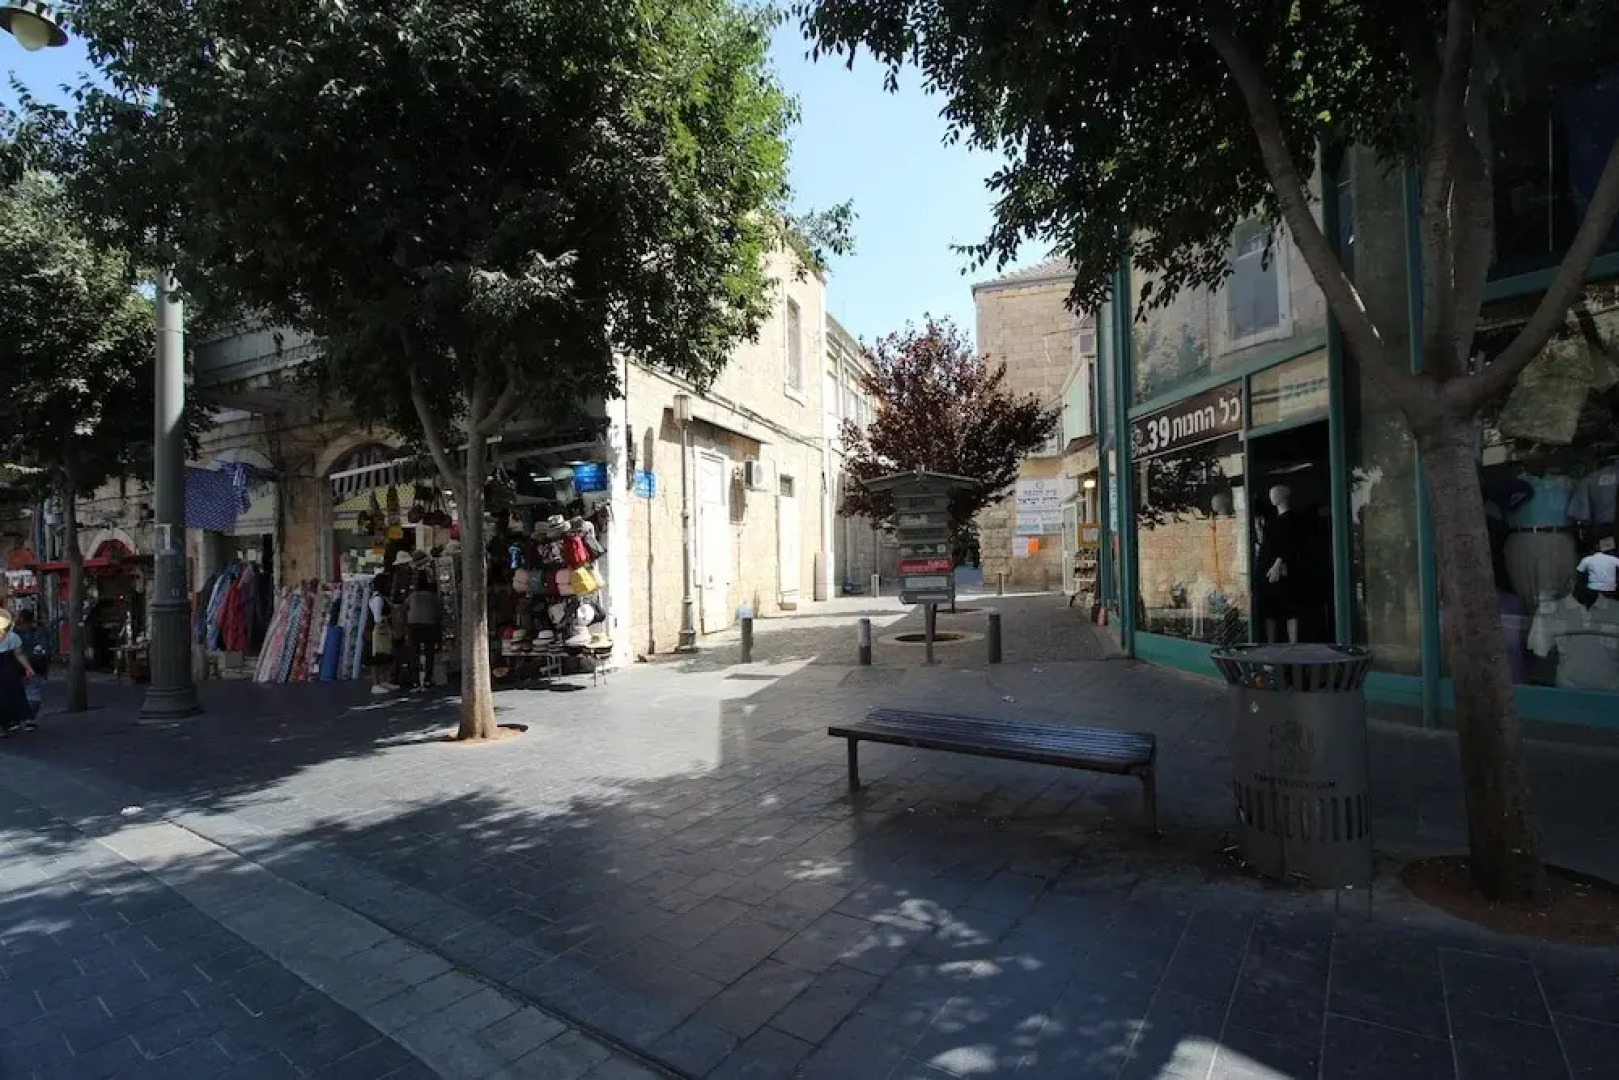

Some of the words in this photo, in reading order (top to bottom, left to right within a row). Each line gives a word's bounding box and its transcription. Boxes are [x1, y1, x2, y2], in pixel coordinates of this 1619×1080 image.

[1172, 405, 1215, 442] החנות
[1218, 396, 1241, 425] כל
[1147, 415, 1170, 451] 39
